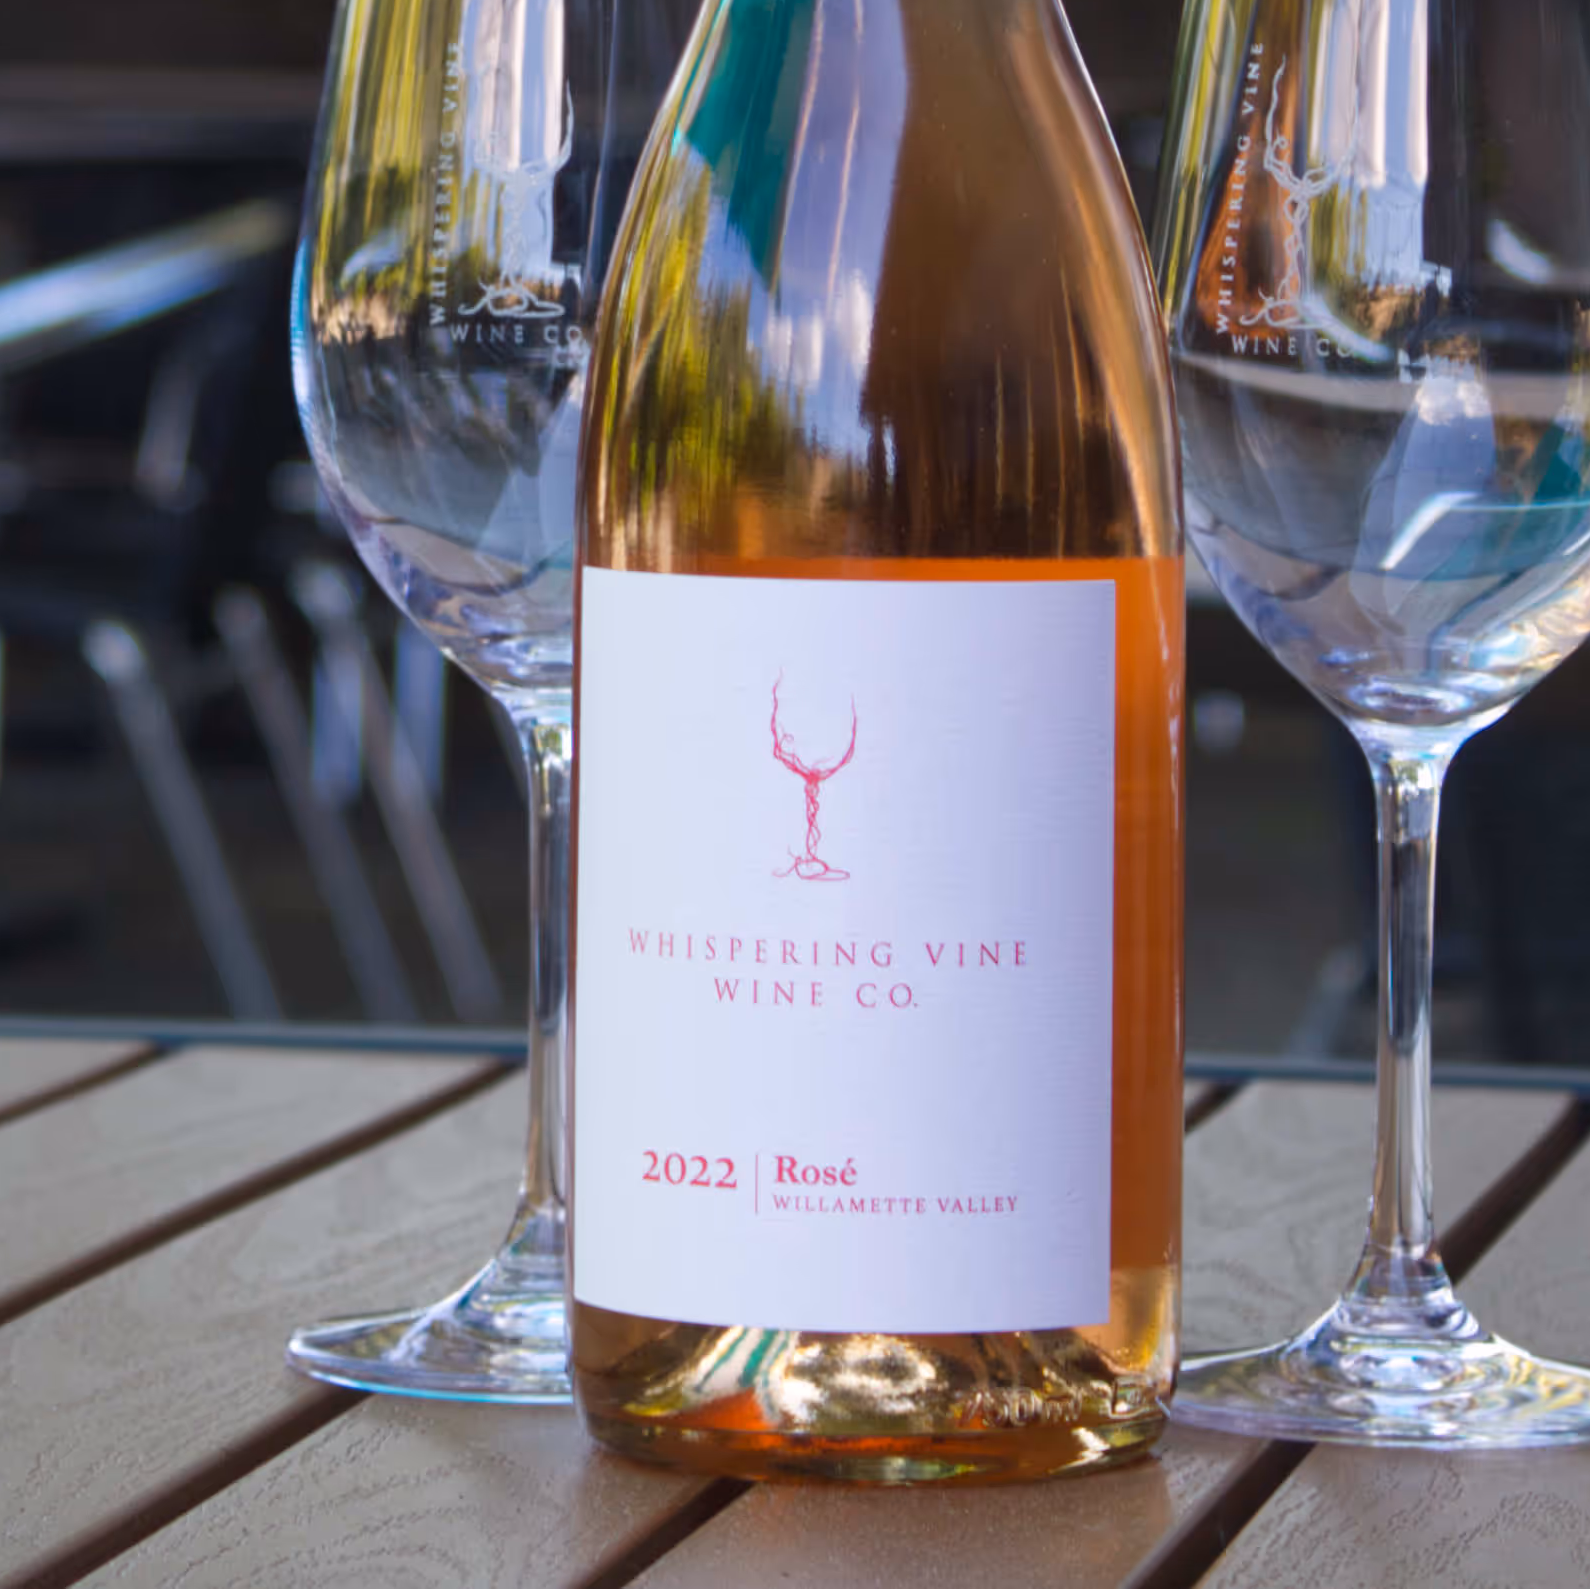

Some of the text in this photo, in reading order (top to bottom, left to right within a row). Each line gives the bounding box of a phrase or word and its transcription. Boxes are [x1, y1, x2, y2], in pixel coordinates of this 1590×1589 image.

[429, 42, 460, 326] WHISPERING VINE
[1215, 42, 1264, 335] WHISPERING VINE
[450, 324, 524, 344] WINE
[1231, 334, 1299, 356] WINE
[627, 926, 1028, 968] WHISPERING VINE
[713, 976, 920, 1010] WINE CO.
[641, 1150, 859, 1190] 2022 Rosé
[772, 1193, 1019, 1215] WILLAMETTE VALLEY
